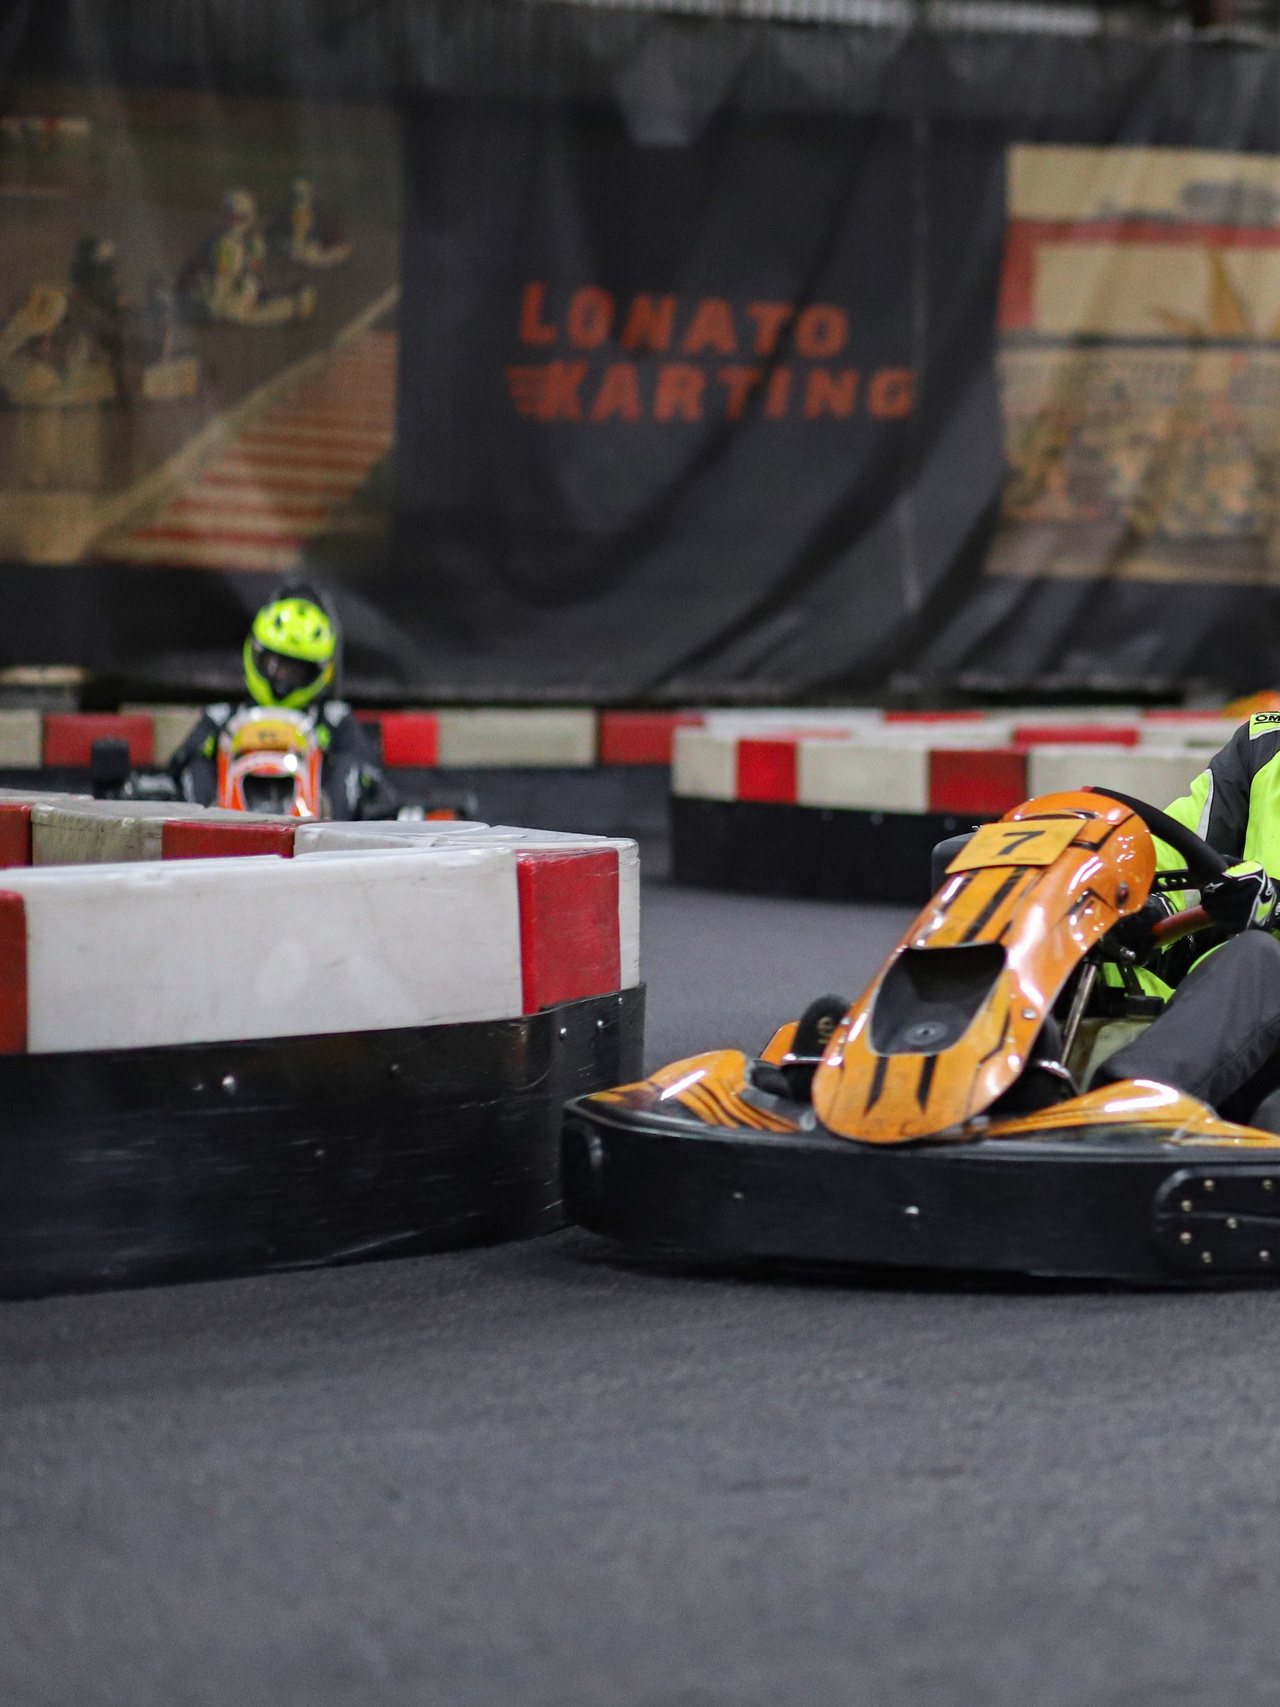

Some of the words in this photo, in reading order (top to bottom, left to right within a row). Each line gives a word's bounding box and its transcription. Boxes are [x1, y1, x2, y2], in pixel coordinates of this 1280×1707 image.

[518, 281, 849, 358] LONATO
[508, 361, 917, 422] KARTING
[998, 830, 1046, 856] 7
